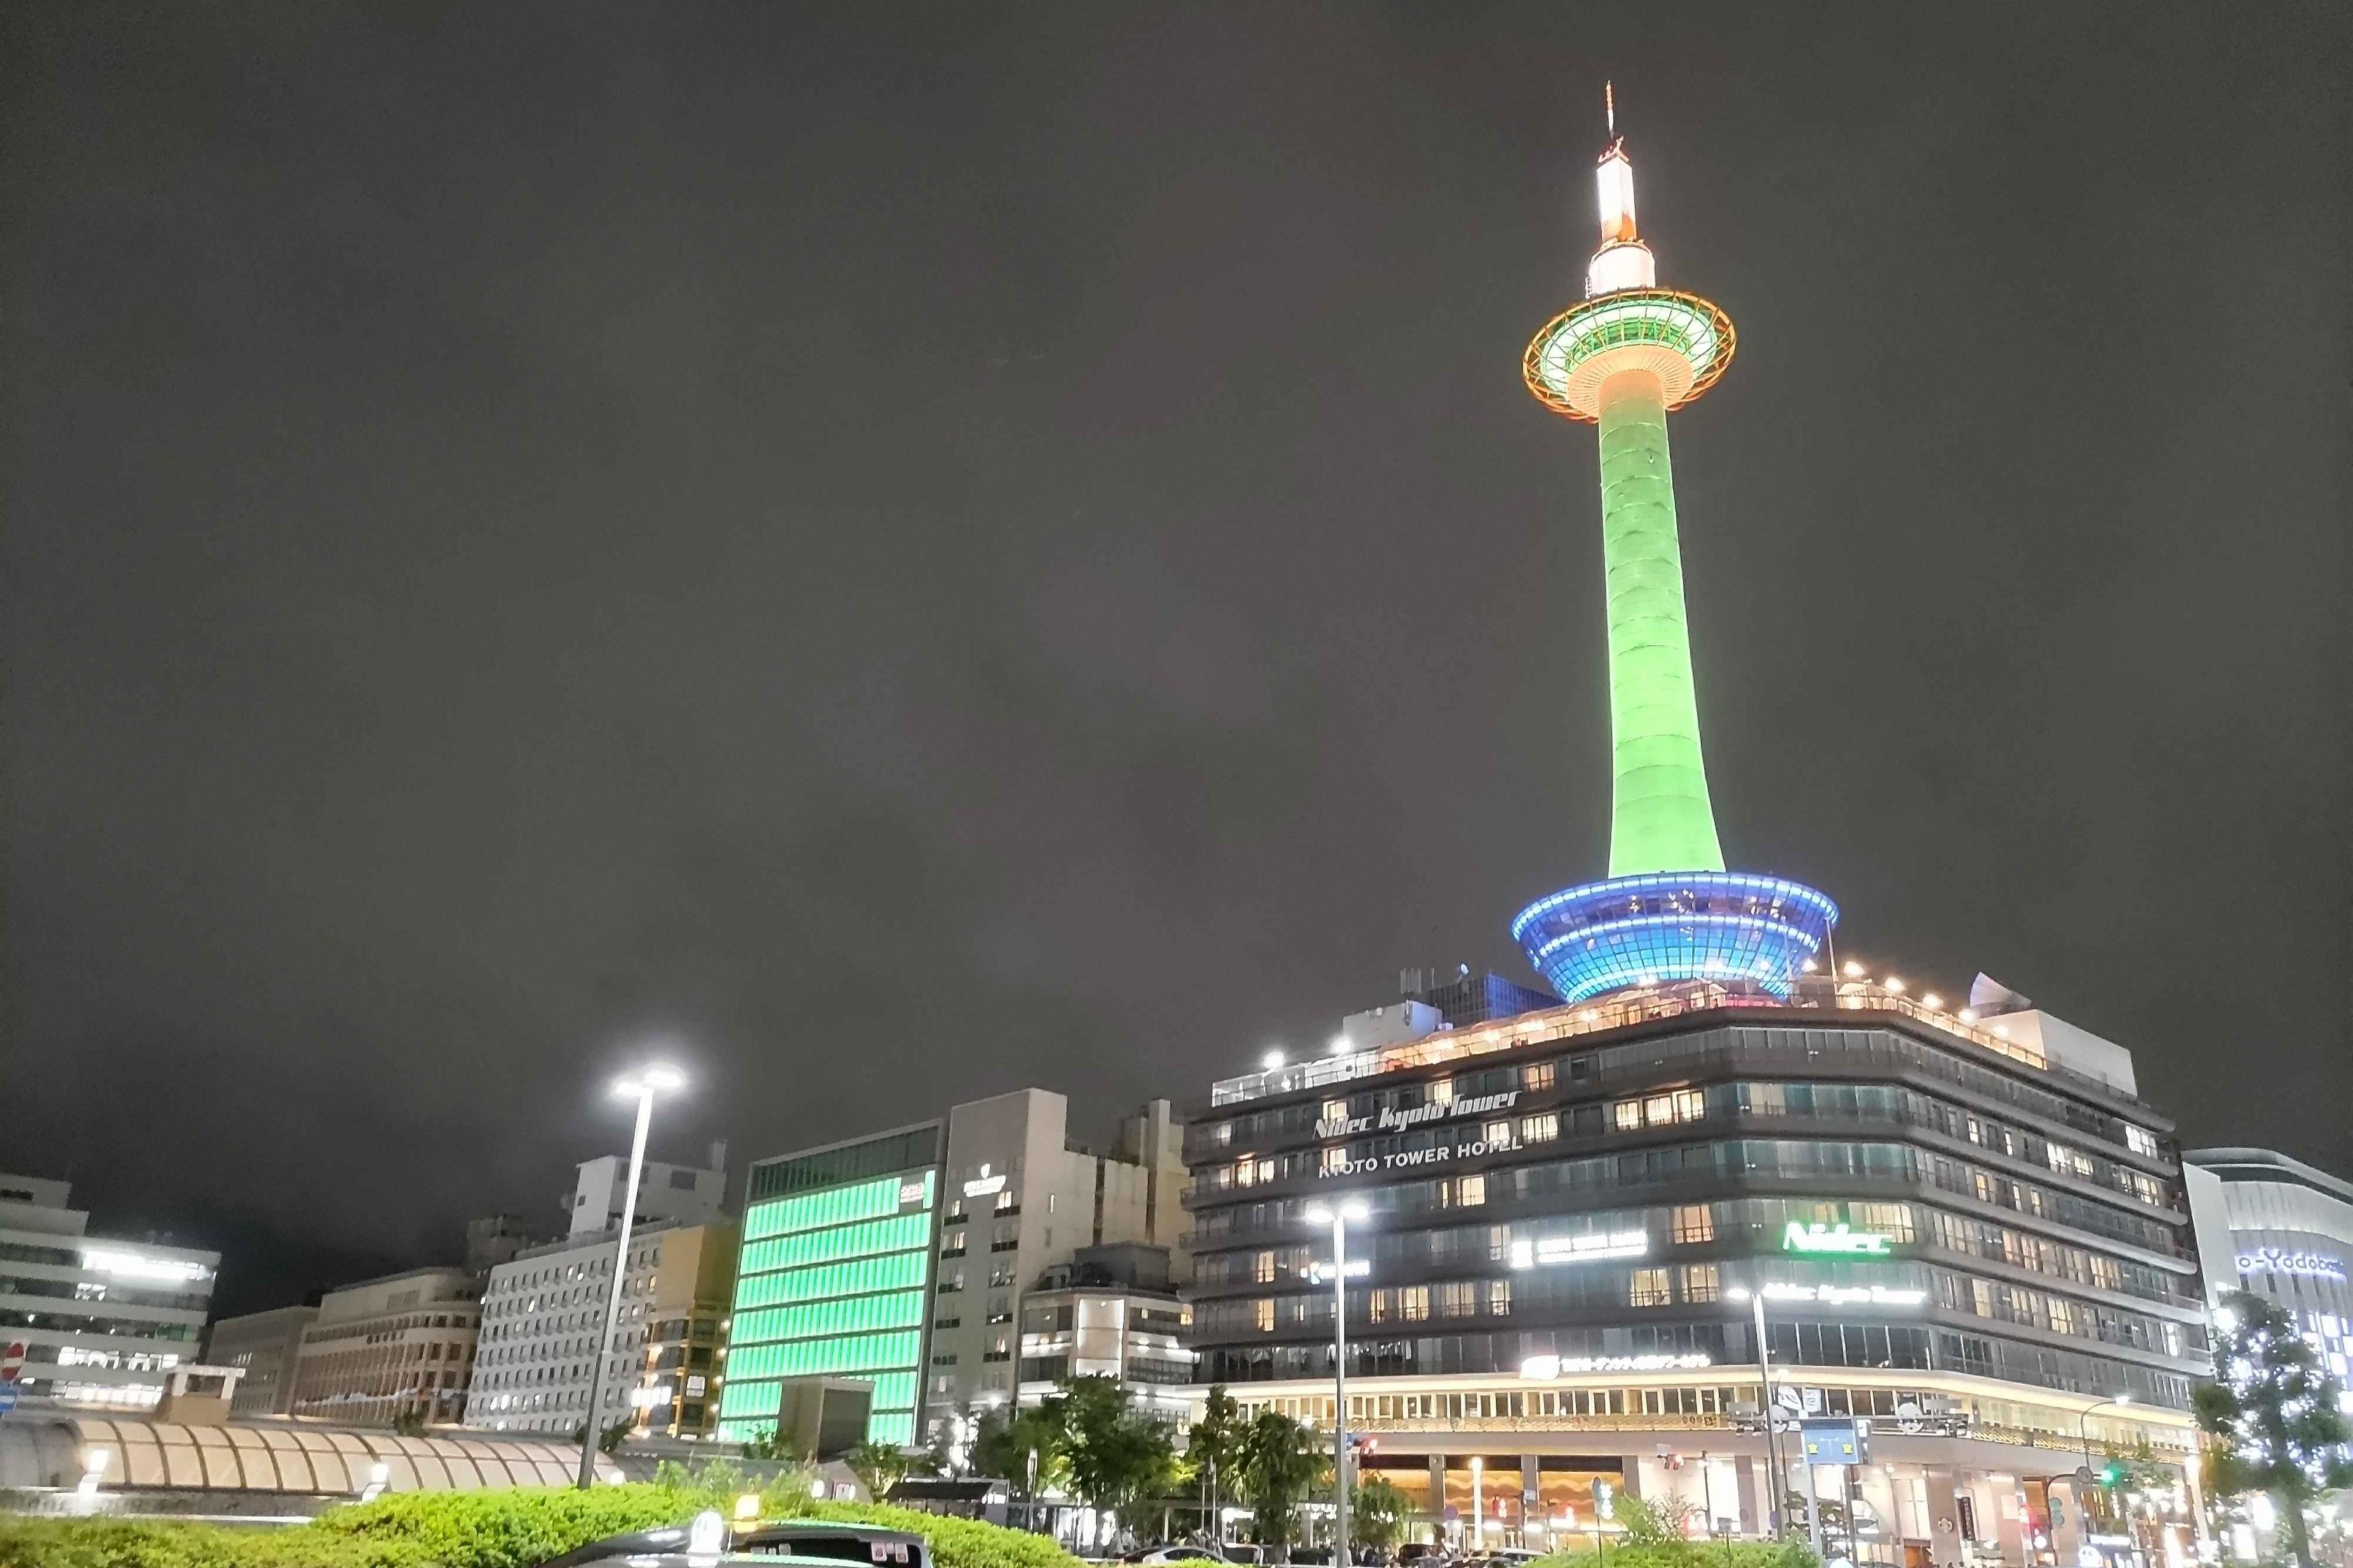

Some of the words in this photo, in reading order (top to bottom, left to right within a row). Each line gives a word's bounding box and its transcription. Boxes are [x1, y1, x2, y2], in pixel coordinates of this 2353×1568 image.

[1313, 1113, 1374, 1140] Nidec
[1378, 1102, 1445, 1132] Kyoto
[1450, 1091, 1522, 1117] Tower
[1319, 1157, 1378, 1179] KYOTO
[1384, 1146, 1449, 1169] TOWER
[1457, 1135, 1523, 1159] HOTEL
